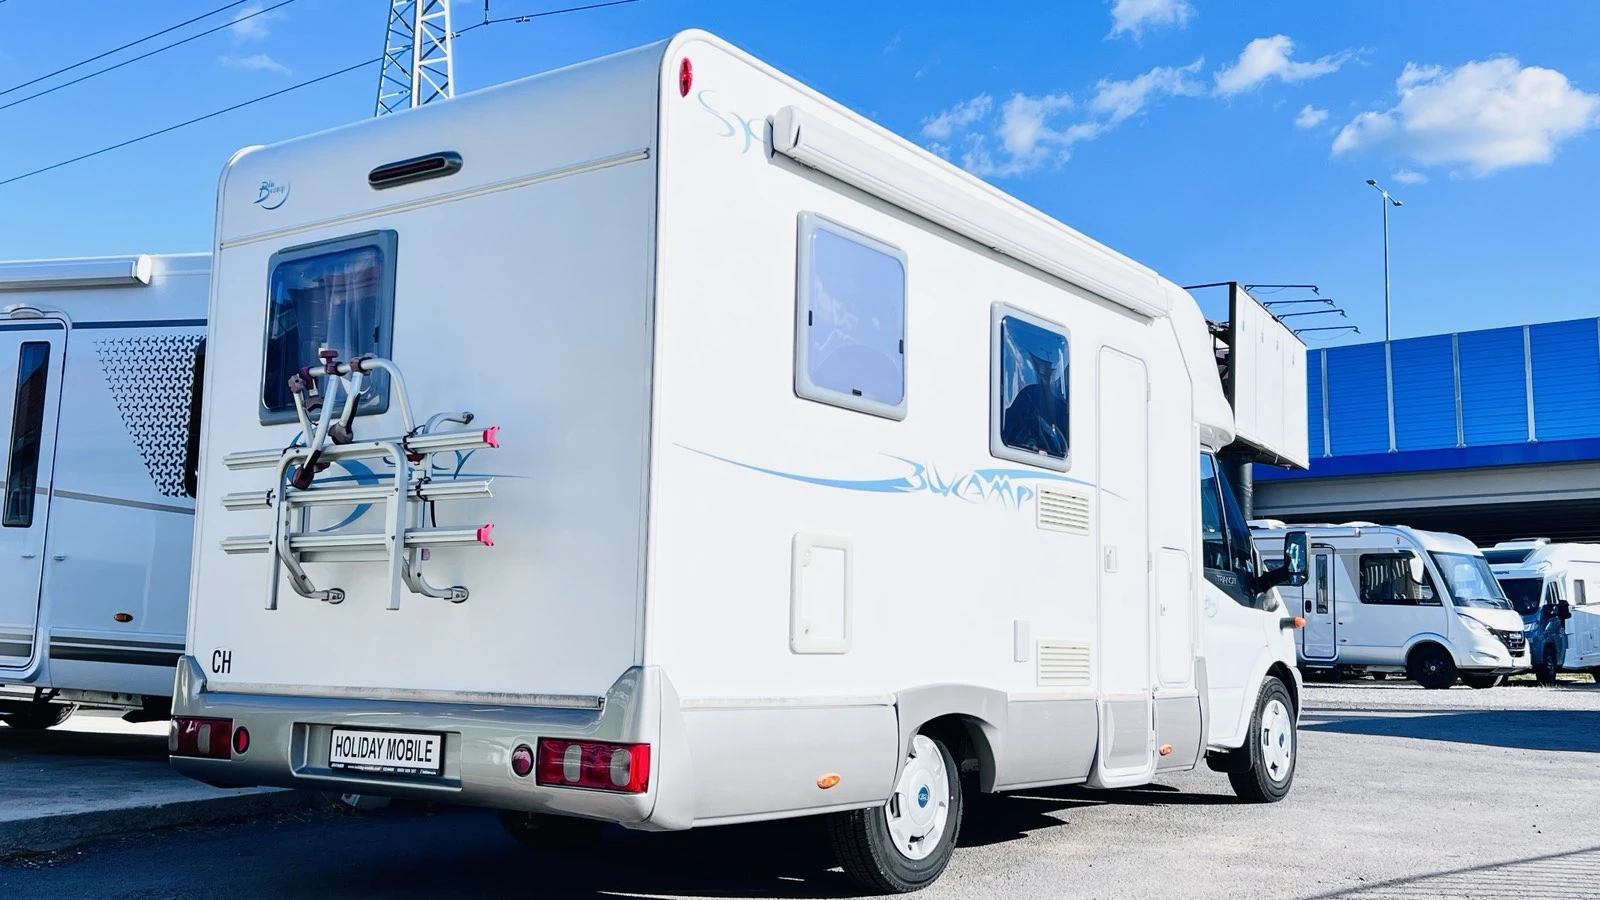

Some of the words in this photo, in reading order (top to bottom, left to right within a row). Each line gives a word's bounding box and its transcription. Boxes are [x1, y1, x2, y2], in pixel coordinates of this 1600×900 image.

[212, 649, 232, 674] CH
[335, 735, 385, 760] HOLIDAY
[386, 738, 433, 763] MOBILE
